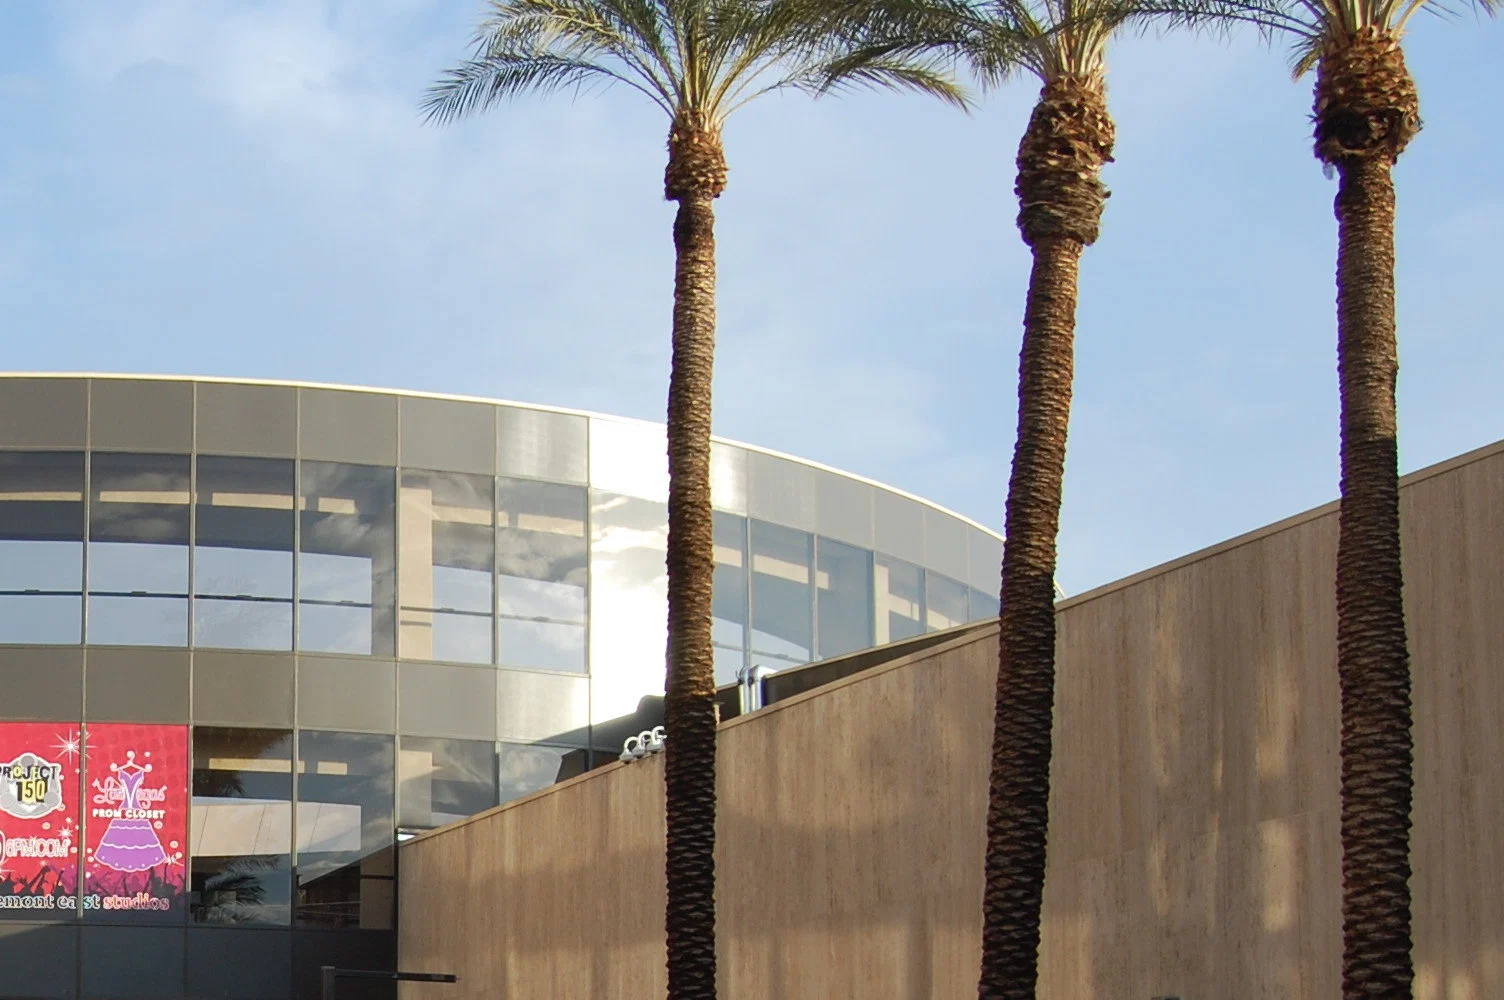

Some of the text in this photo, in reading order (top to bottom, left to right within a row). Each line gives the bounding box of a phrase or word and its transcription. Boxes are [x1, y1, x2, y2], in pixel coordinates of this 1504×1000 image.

[16, 778, 48, 803] 150
[92, 809, 166, 819] PROM CLOSET
[103, 892, 170, 910] studios
